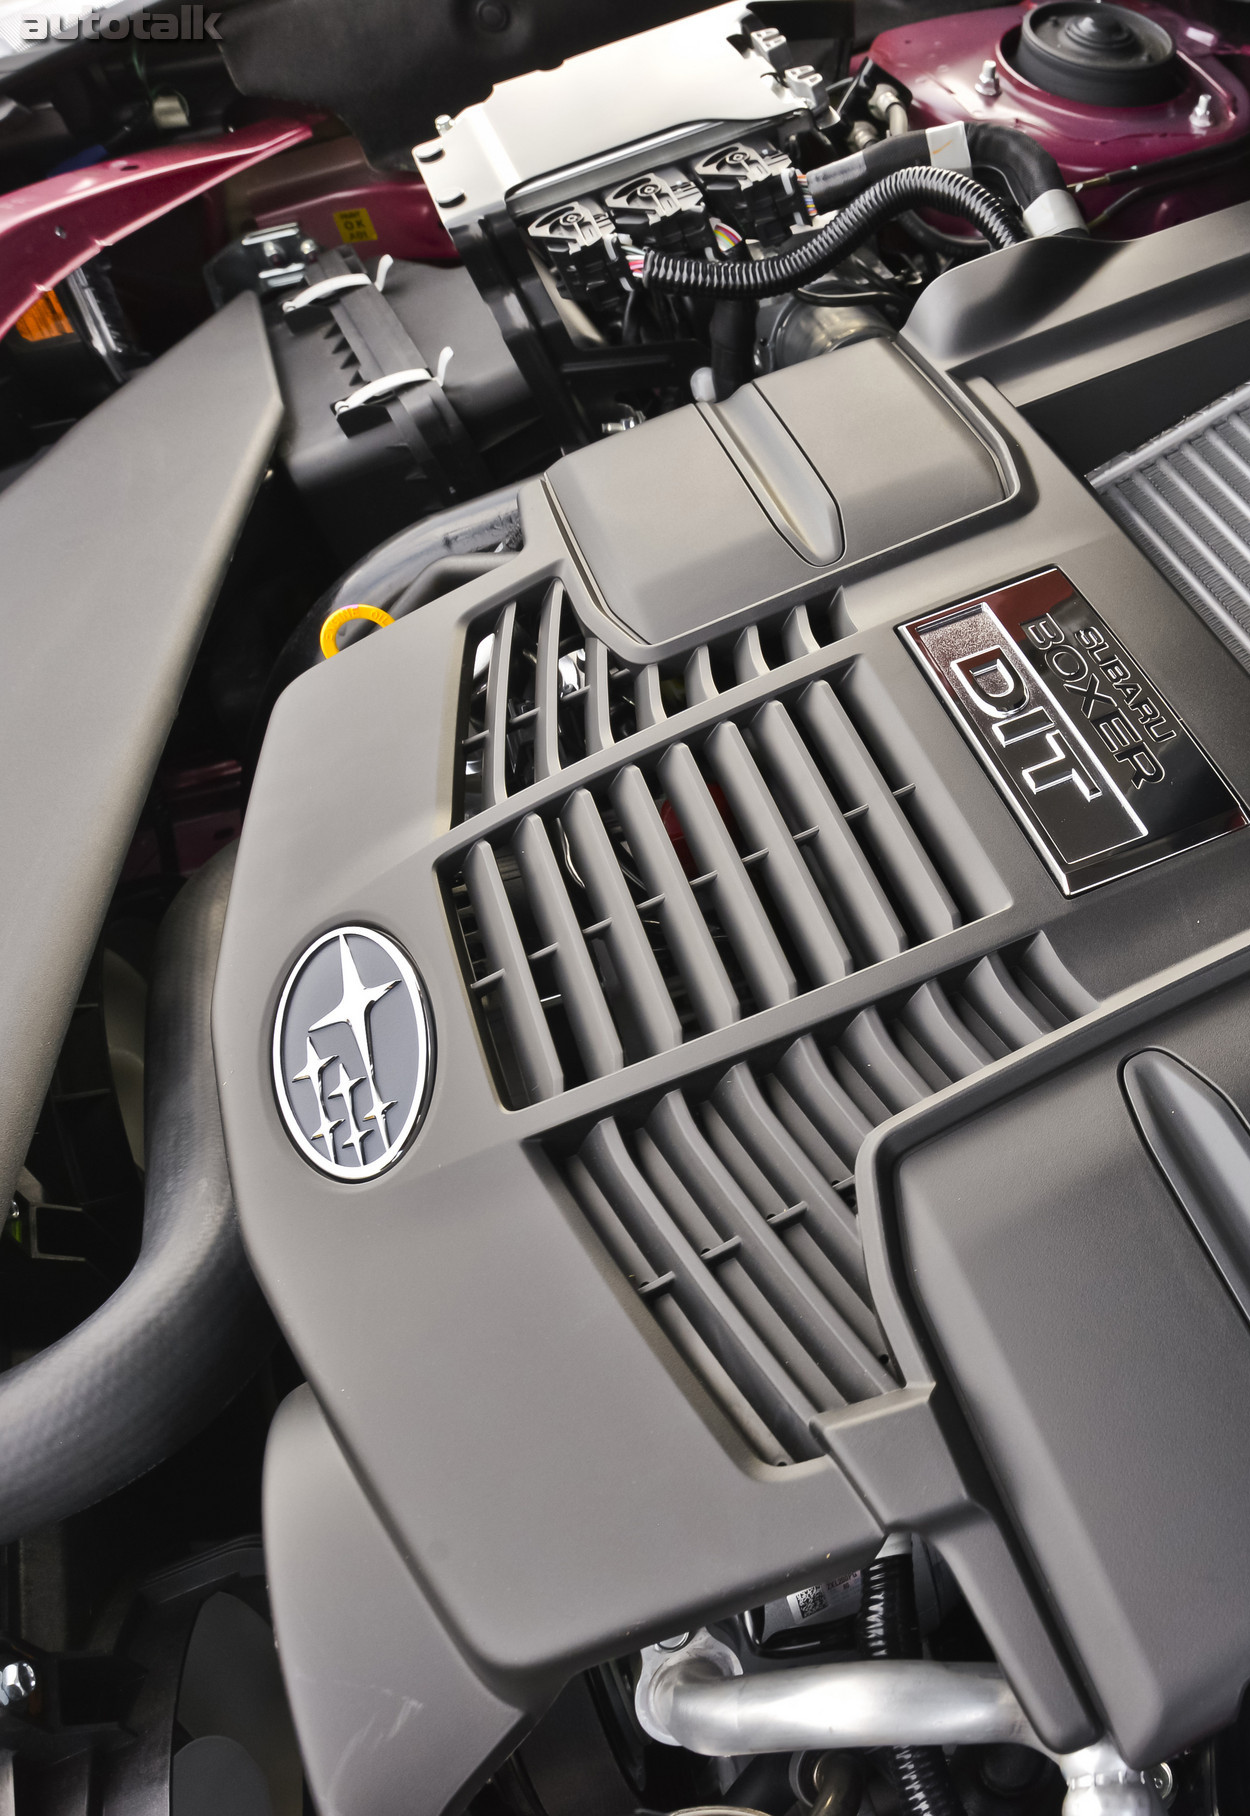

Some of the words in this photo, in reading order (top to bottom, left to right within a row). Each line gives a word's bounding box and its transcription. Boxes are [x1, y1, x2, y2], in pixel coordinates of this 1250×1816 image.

[951, 645, 1102, 802] DIT
[1019, 612, 1166, 790] BOXER
[1074, 626, 1177, 743] SUBARU
